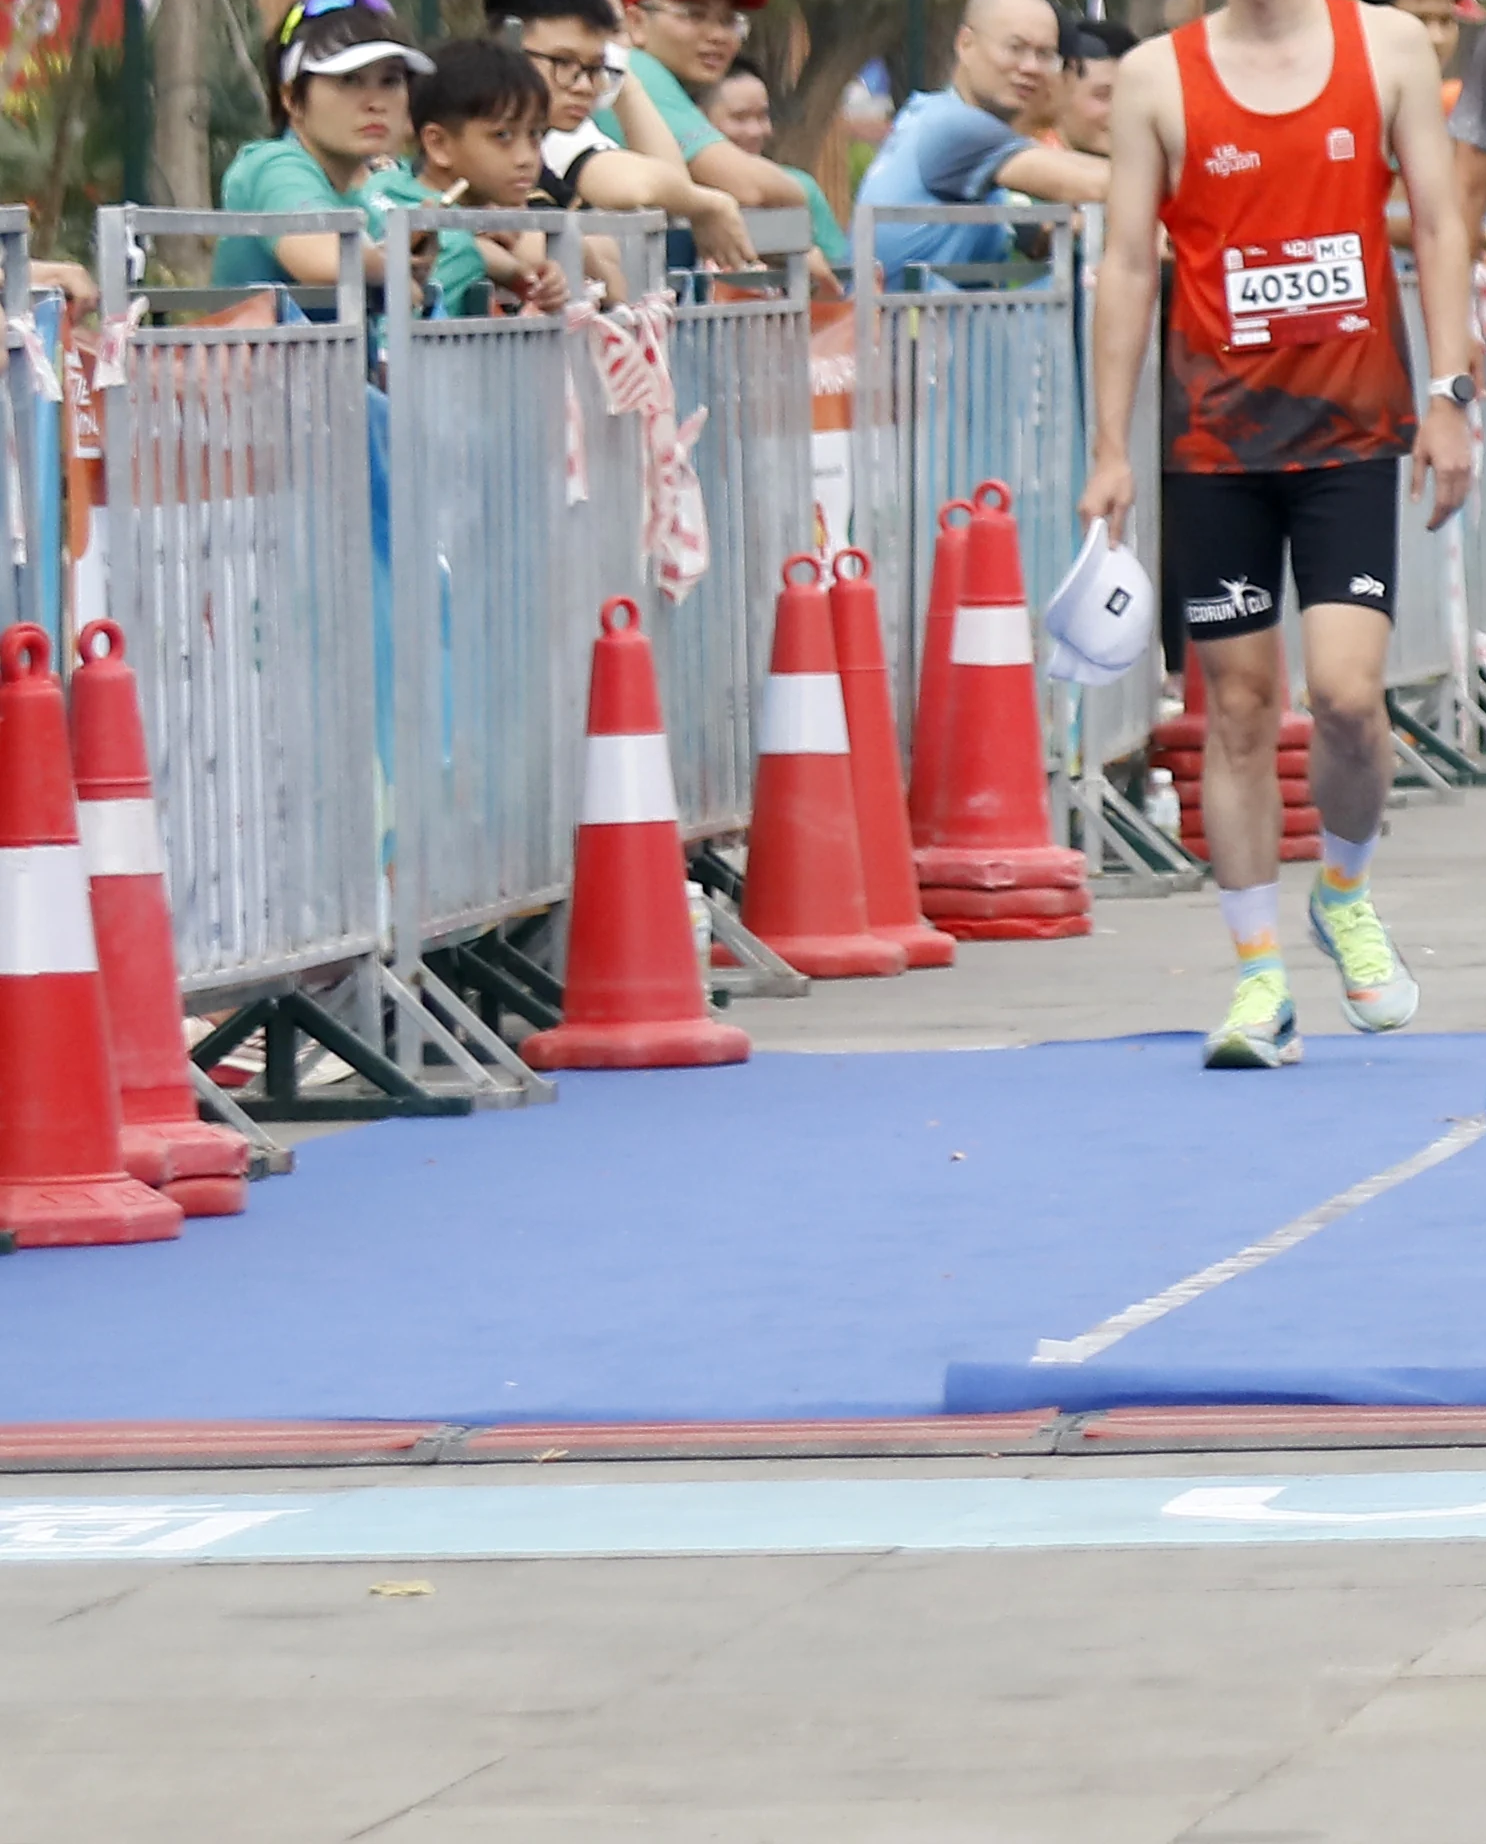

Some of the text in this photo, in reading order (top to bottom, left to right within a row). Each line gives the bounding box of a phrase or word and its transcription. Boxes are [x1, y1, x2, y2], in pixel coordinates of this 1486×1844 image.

[1320, 240, 1355, 257] M C
[1240, 266, 1353, 305] 40305
